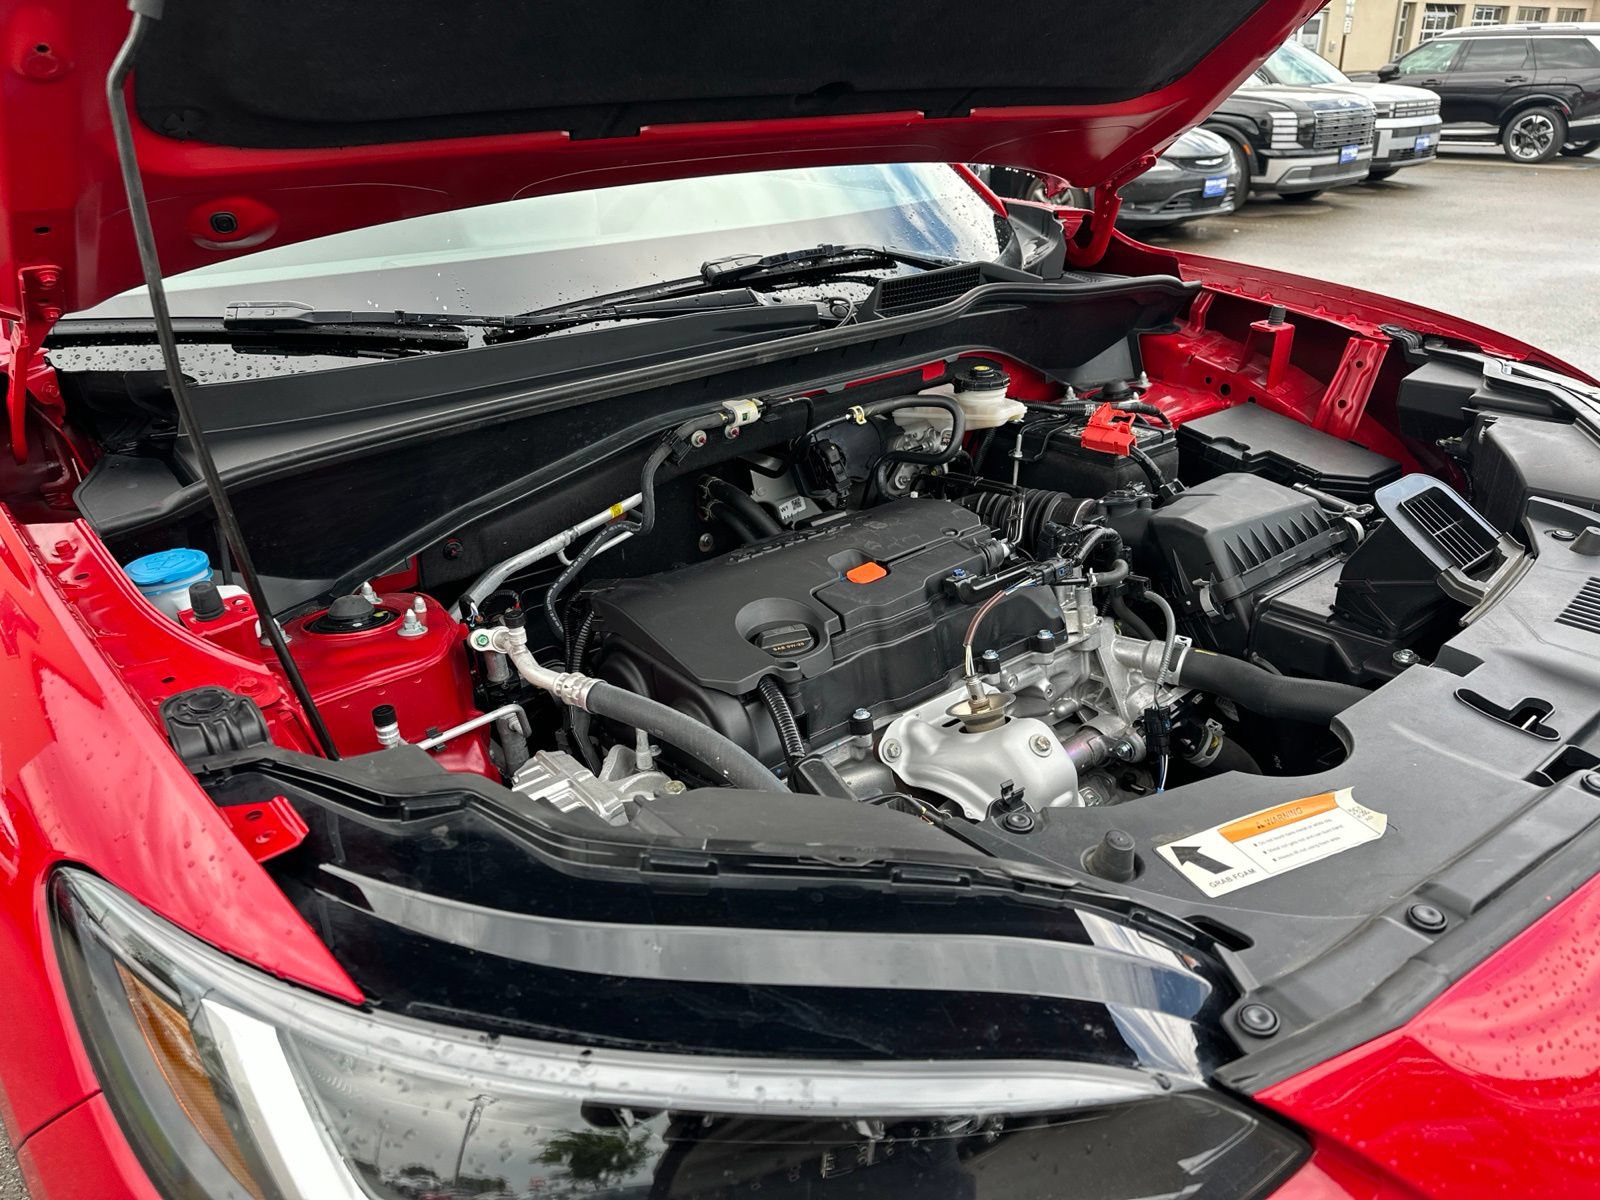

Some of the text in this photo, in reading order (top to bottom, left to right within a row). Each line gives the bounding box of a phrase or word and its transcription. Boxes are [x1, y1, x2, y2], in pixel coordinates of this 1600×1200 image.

[1264, 807, 1303, 825] WARNING
[1209, 868, 1256, 888] GRAB FOAM
